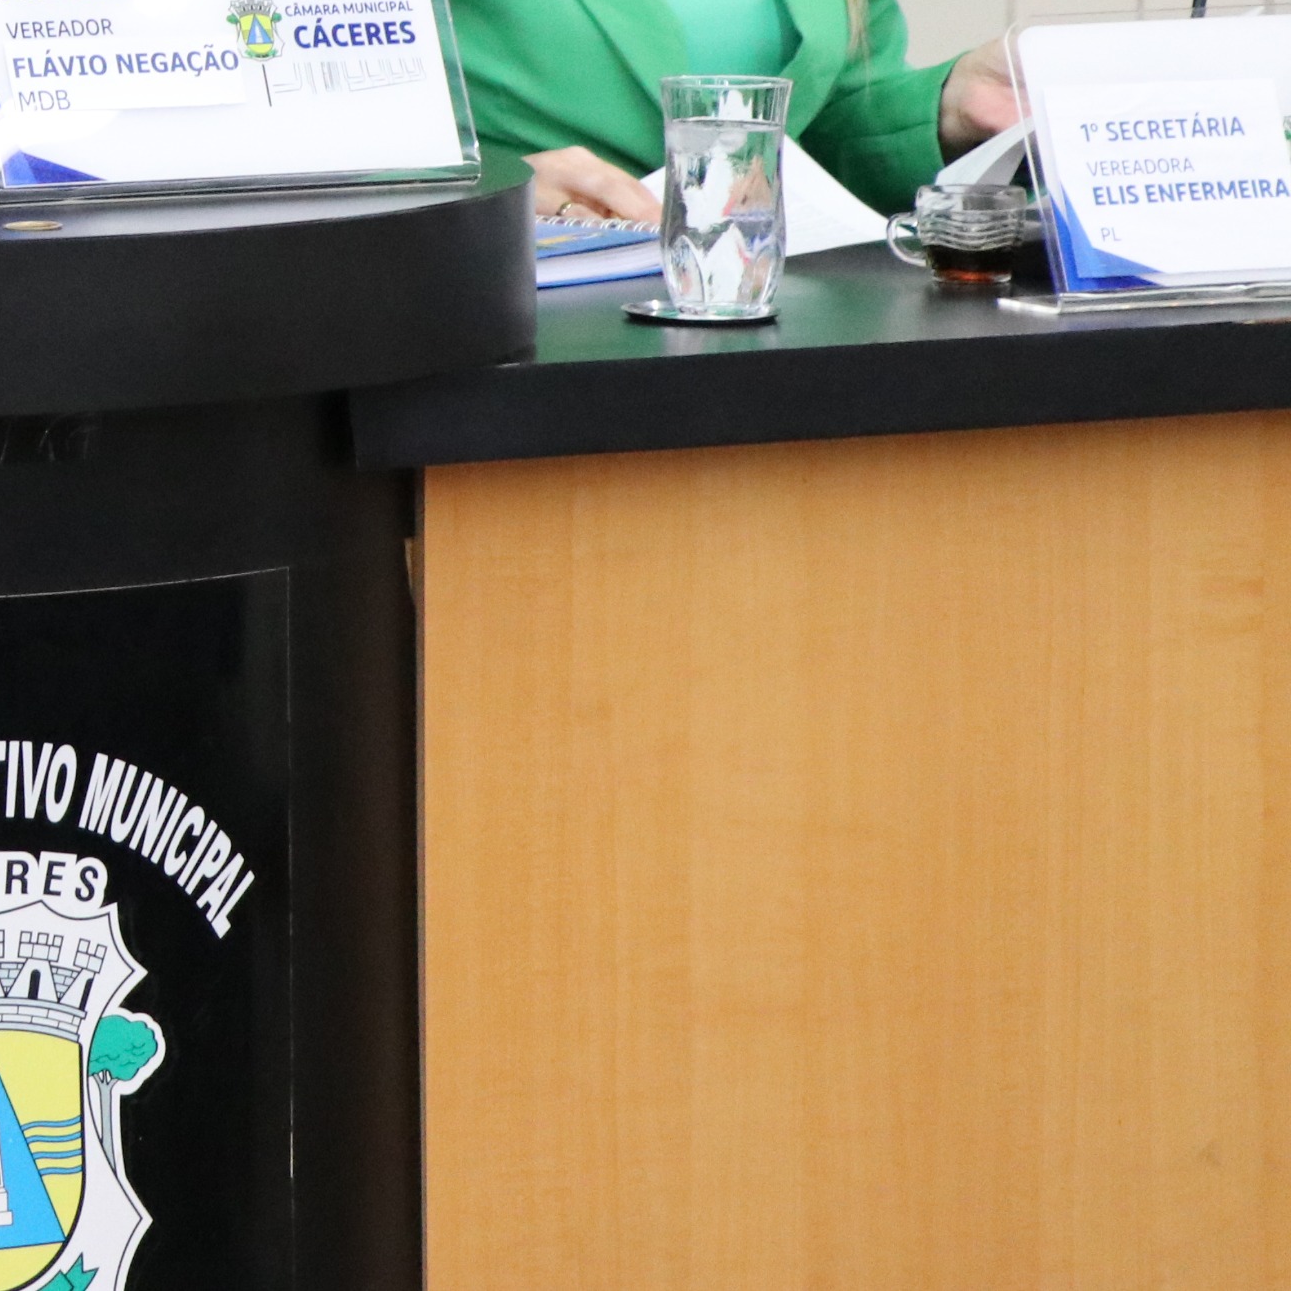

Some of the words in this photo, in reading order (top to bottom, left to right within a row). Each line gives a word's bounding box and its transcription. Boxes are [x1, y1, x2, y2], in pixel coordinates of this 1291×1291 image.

[284, 1, 340, 17] CÂMARA
[343, 0, 414, 14] MUNICIPAL
[6, 18, 113, 39] VEREADOR
[293, 19, 416, 49] CÁCERES
[13, 49, 108, 79] FLÁVIO
[115, 44, 240, 78] NEGAÇÃO
[18, 89, 71, 112] MDB
[1106, 112, 1246, 143] SECRETÁRIA
[1086, 157, 1195, 177] VEREADORA
[1092, 184, 1140, 206] ELIS
[1144, 178, 1291, 204] ENFERMEIRA
[1100, 226, 1122, 242] PL
[78, 753, 256, 940] MUNICIPAL
